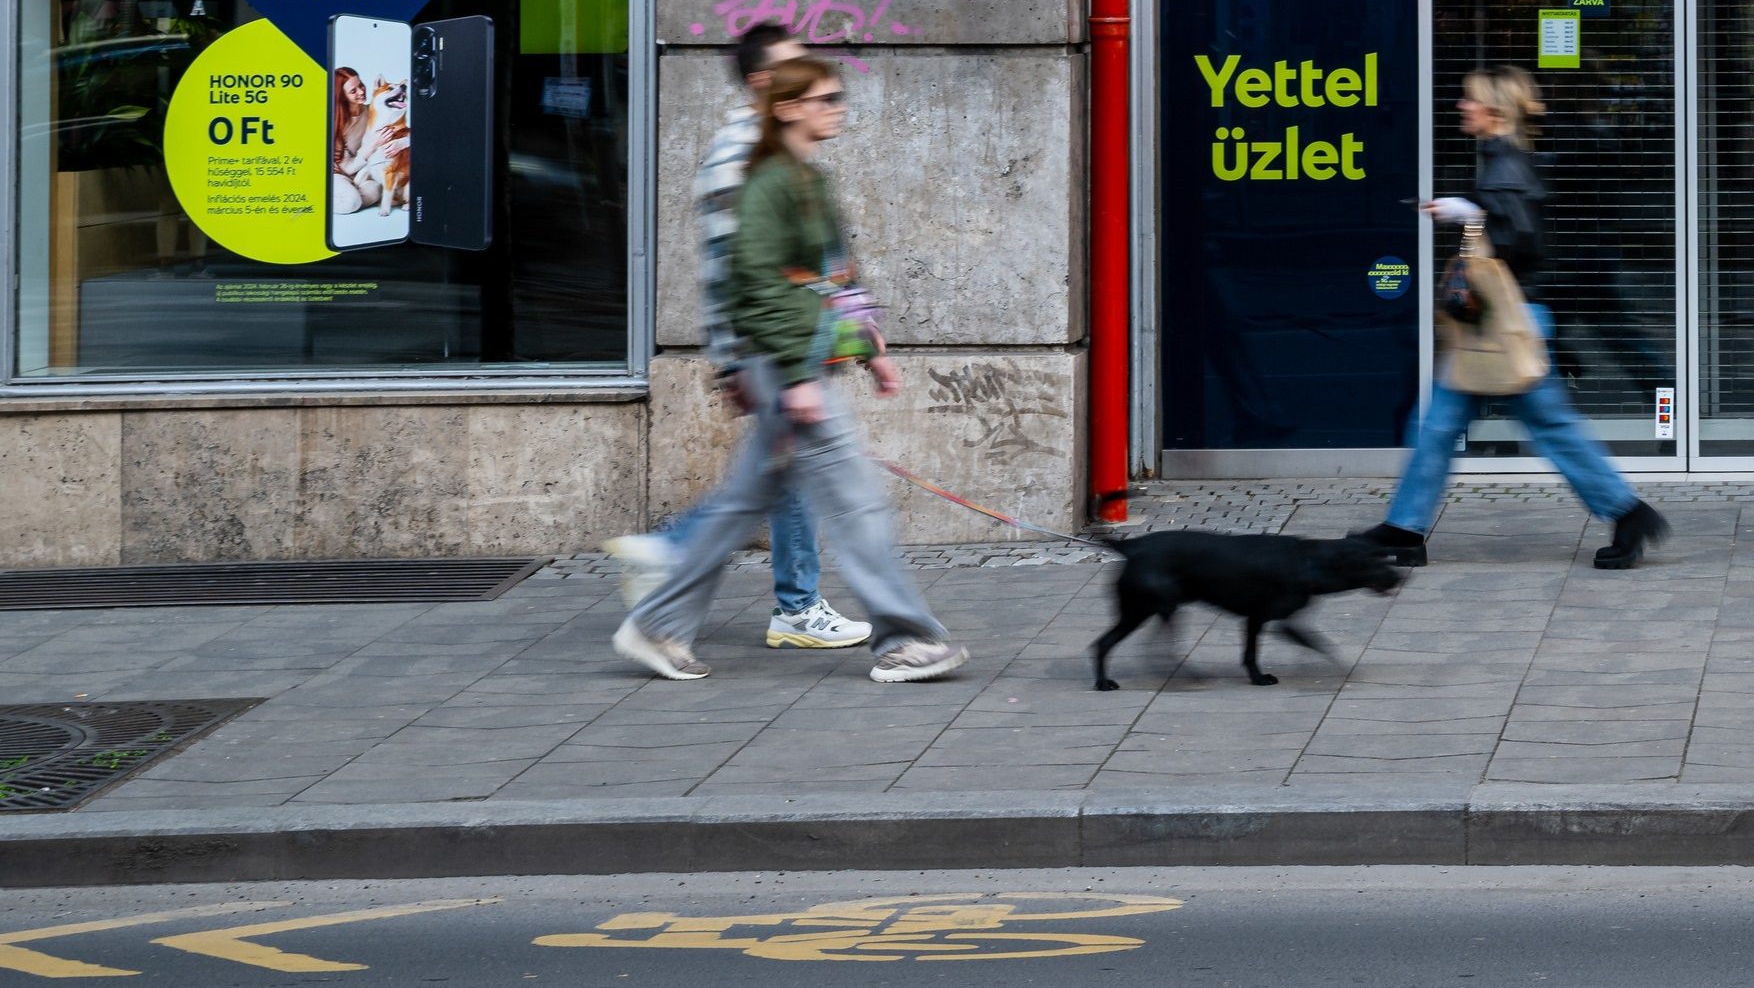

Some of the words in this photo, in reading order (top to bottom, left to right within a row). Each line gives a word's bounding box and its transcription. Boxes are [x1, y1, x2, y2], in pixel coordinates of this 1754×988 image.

[209, 75, 276, 88] HONOR
[281, 74, 304, 88] 90
[1193, 52, 1378, 108] Yettel
[209, 91, 240, 104] Lite
[244, 91, 269, 104] 5G
[208, 116, 234, 145] 0
[241, 117, 276, 145] Ft
[1212, 125, 1367, 181] üzlet
[283, 156, 289, 164] 2
[292, 156, 303, 165] év
[287, 168, 296, 176] Ft
[248, 194, 280, 203] emelés
[269, 206, 279, 214] és
